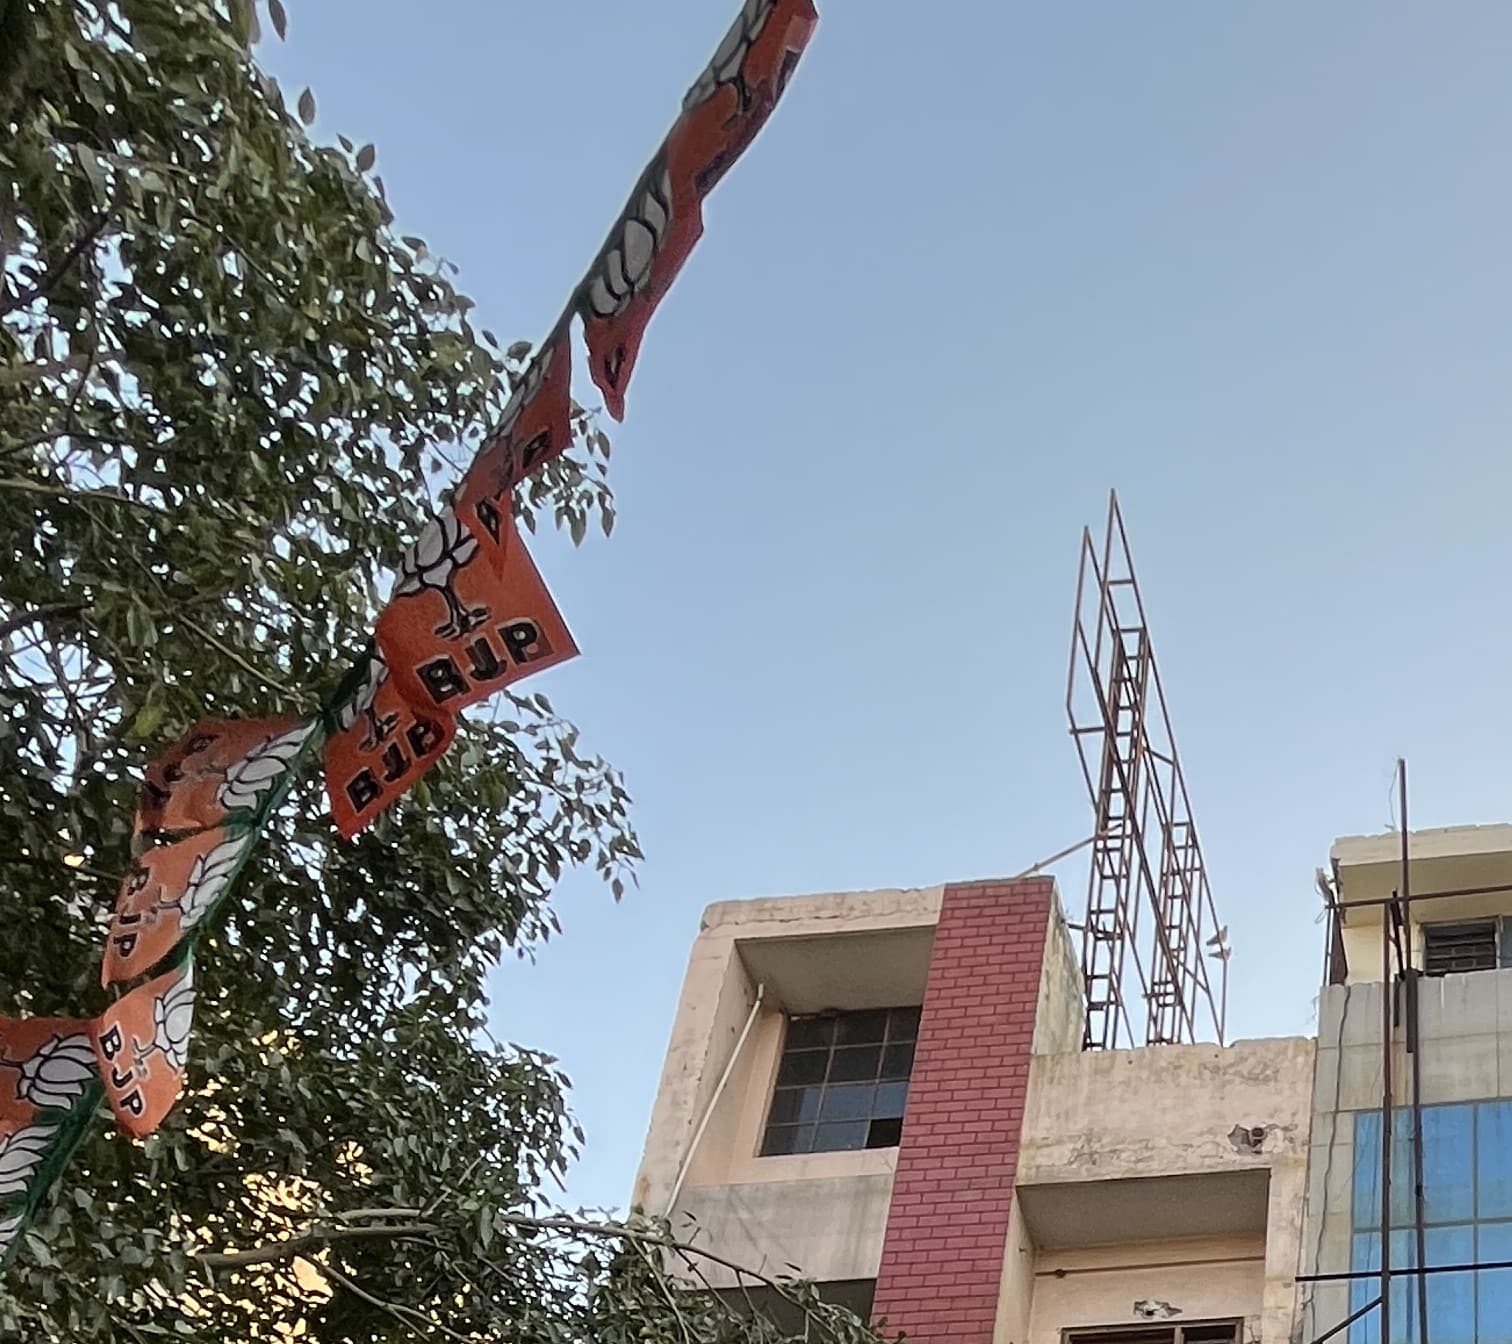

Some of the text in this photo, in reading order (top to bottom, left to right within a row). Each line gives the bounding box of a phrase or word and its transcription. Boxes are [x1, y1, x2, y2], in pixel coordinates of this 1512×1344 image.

[415, 618, 554, 703] BJP
[345, 711, 445, 813] BJP
[98, 1025, 143, 1116] BJP
